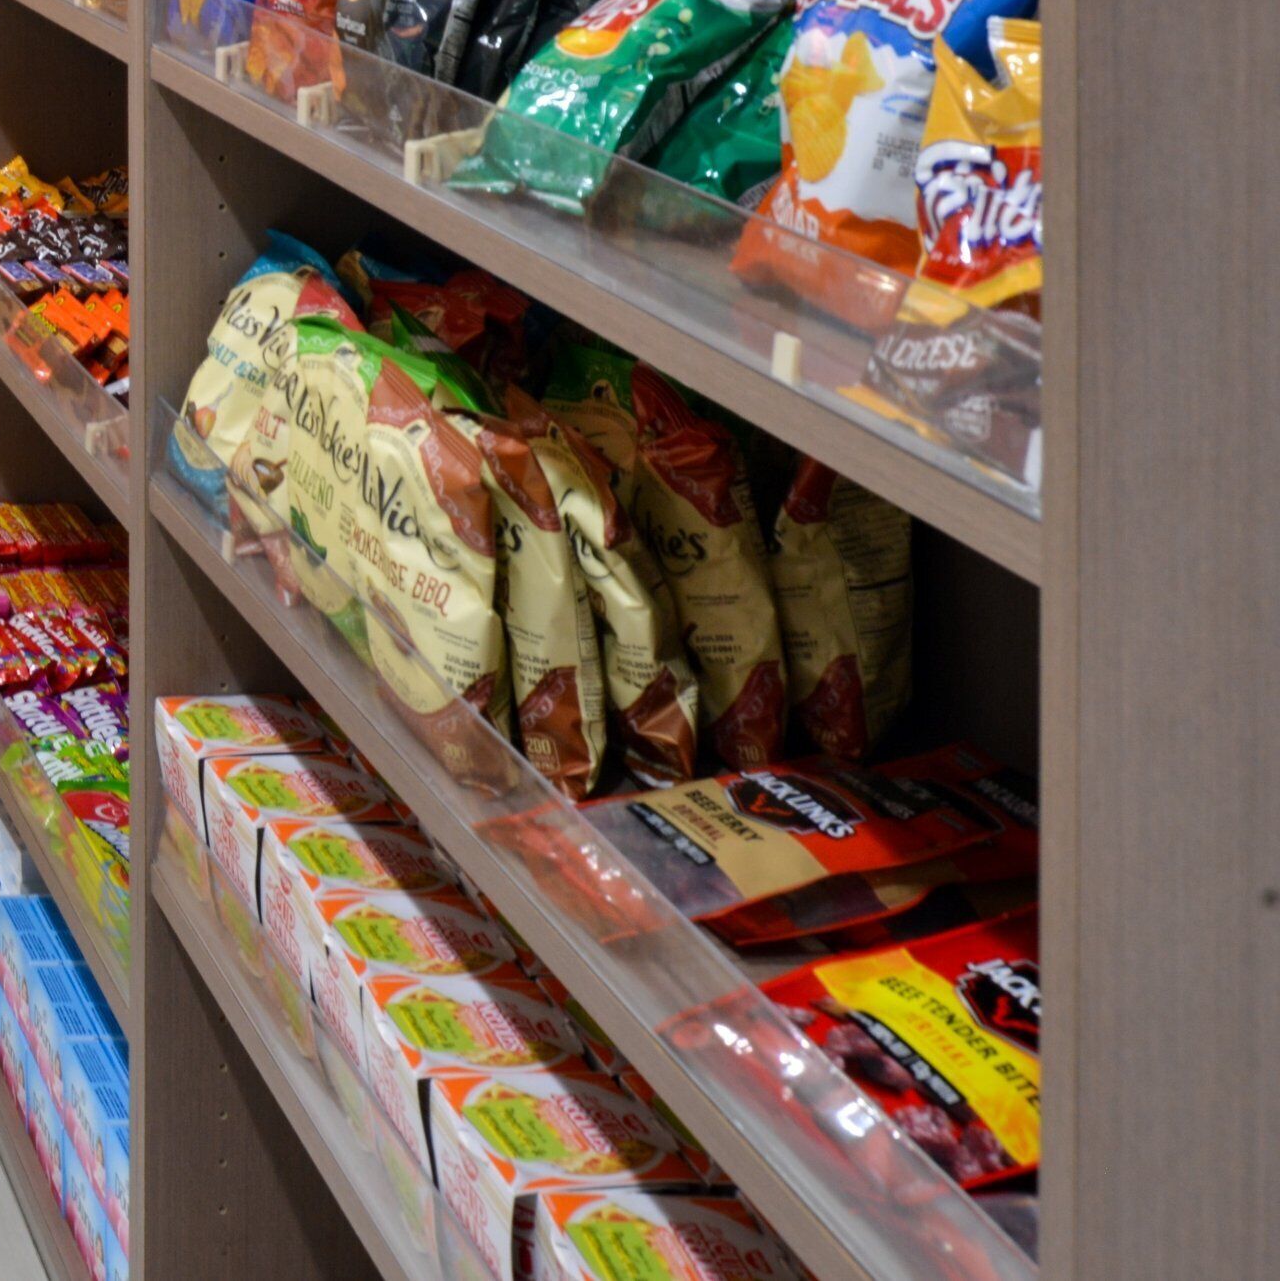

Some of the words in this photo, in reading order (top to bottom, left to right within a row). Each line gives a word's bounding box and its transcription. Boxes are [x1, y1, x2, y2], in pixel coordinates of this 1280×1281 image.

[916, 141, 1042, 251] Frit
[411, 571, 453, 617] BBQ
[526, 736, 552, 754] 200
[683, 789, 716, 814] BEEF
[878, 975, 924, 1004] BEEF
[922, 995, 999, 1063] TENDER
